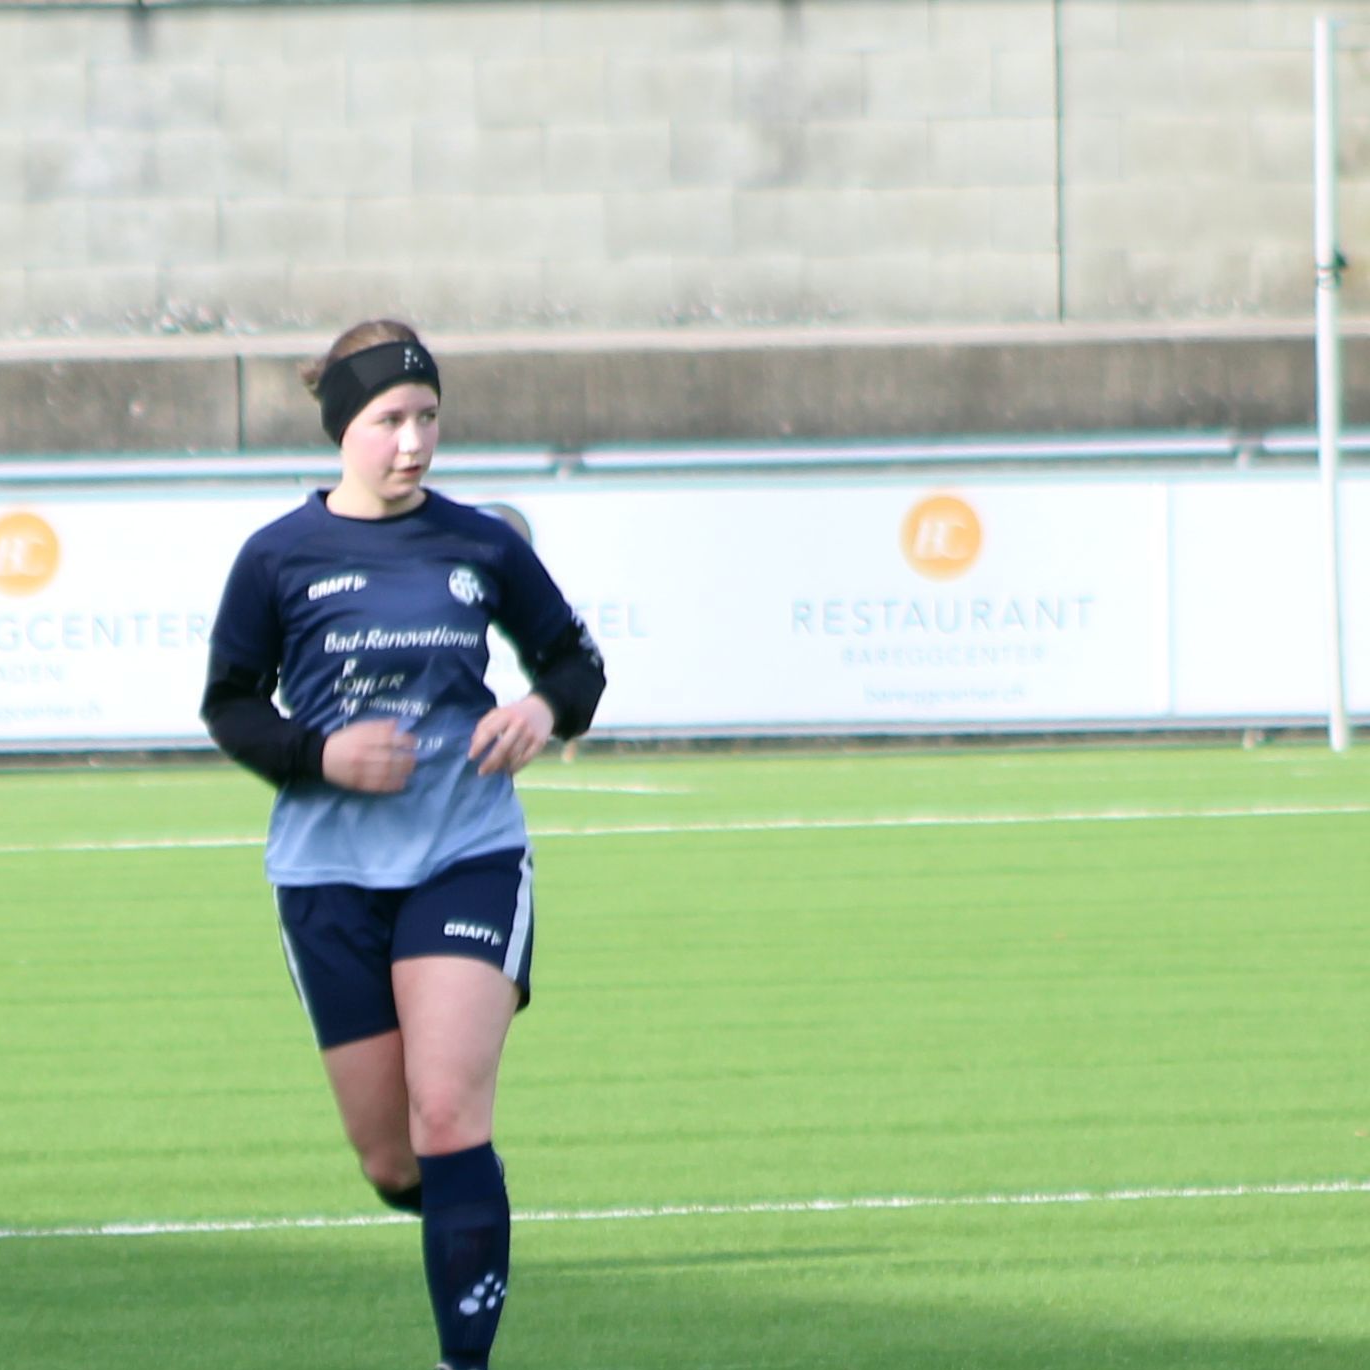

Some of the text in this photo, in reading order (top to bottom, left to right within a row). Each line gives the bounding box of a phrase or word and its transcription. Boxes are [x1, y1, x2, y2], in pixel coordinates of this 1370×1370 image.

[791, 592, 1098, 636] RESTAURANT
[324, 625, 480, 655] Bad-Renovationen
[443, 921, 492, 943] CRAFT
